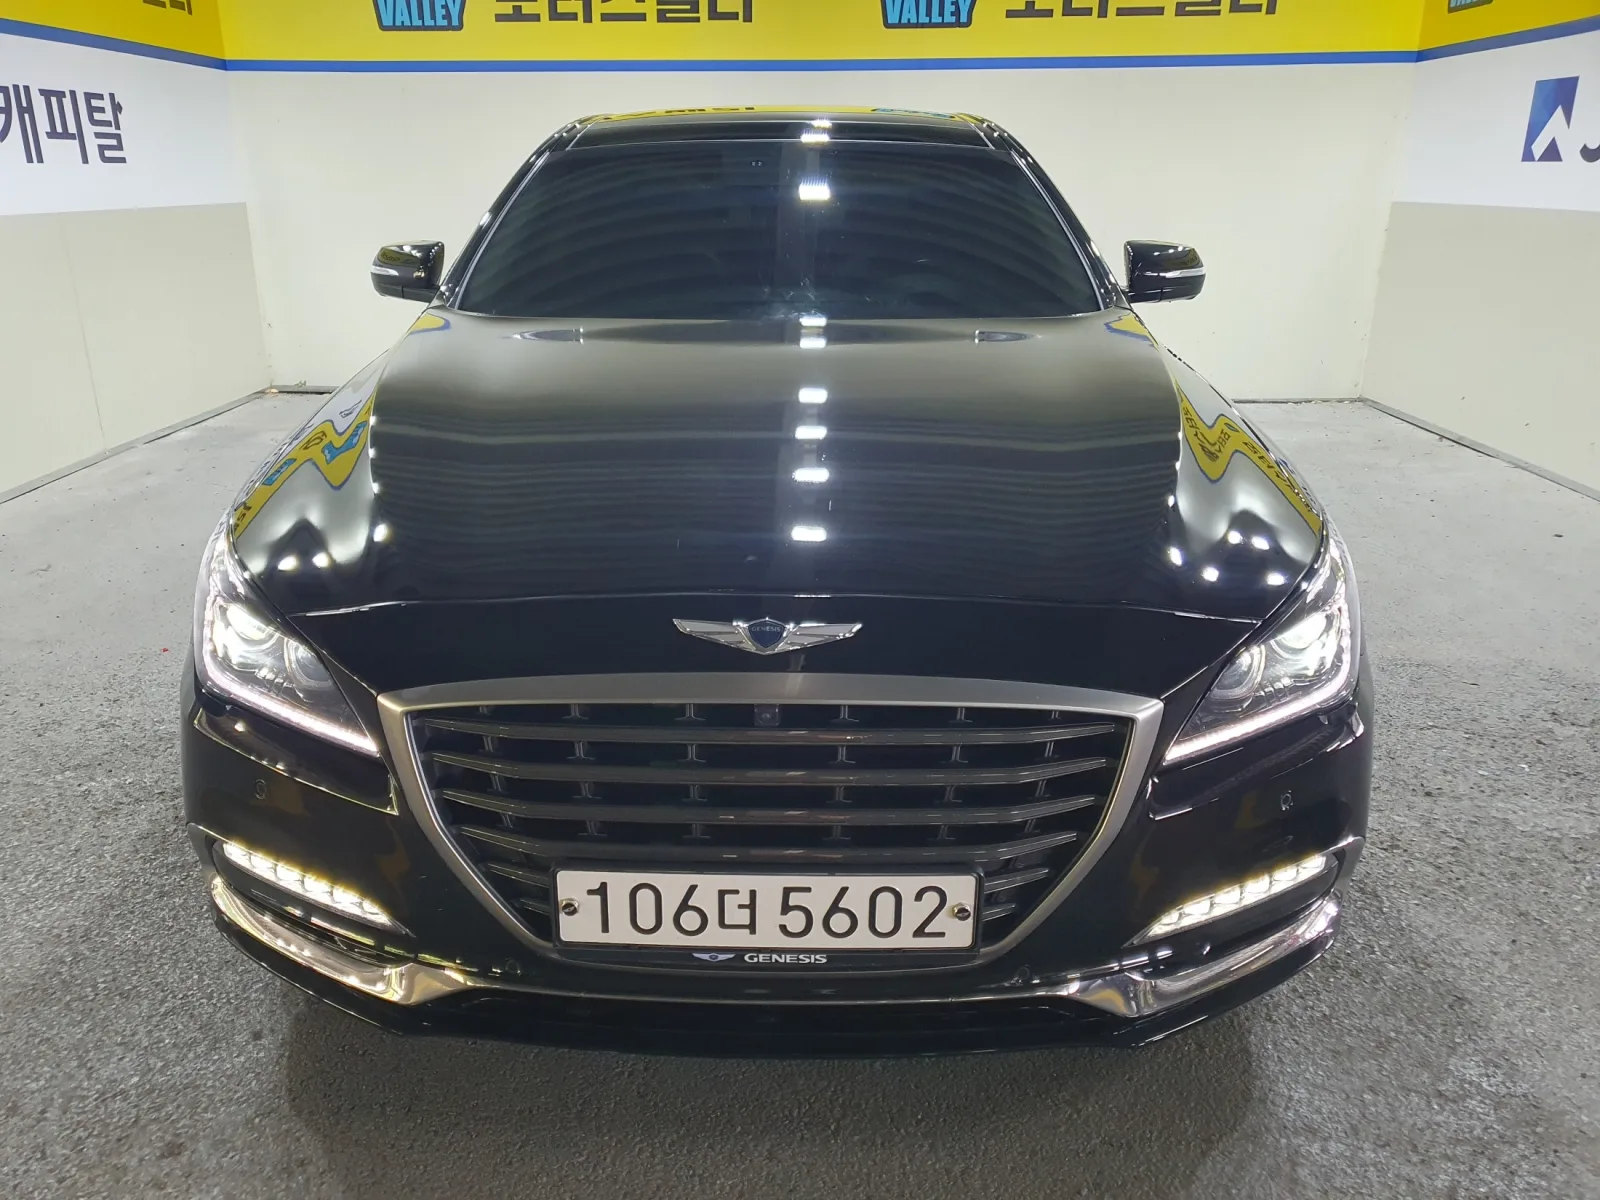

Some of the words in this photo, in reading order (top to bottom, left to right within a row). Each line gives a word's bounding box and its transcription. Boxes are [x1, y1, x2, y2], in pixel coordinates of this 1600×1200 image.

[377, 0, 461, 26] VALLEY
[885, 0, 971, 24] VALLEY
[0, 84, 127, 165] 캐피탈
[743, 953, 828, 964] GENESIS
